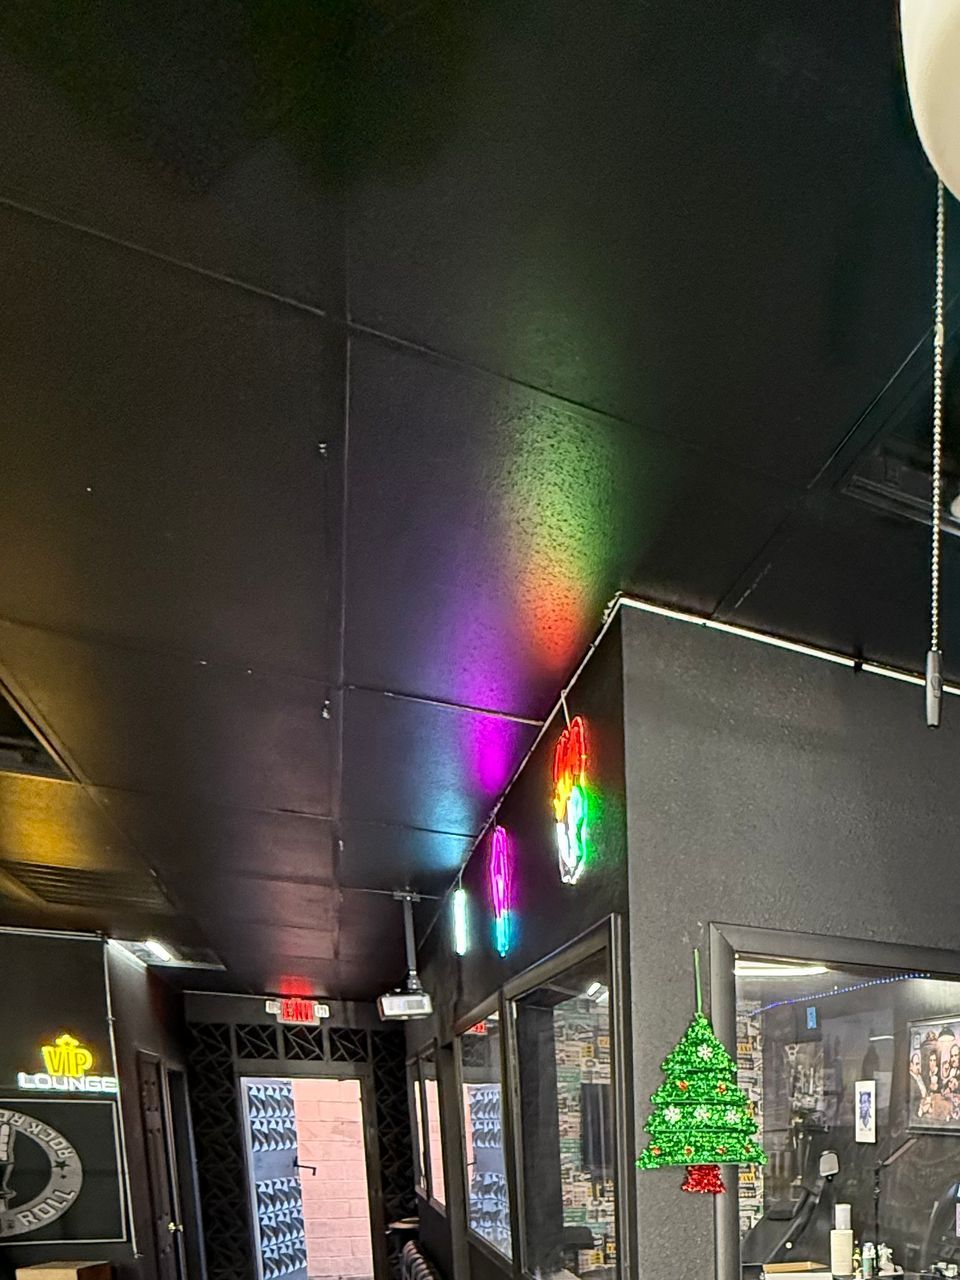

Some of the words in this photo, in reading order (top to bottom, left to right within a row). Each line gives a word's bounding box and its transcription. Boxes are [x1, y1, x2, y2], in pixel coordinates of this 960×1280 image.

[41, 1046, 93, 1077] VIP
[17, 1071, 118, 1093] LOUNGE
[27, 1122, 75, 1158] ROCK
[17, 1190, 76, 1226] ROLL
